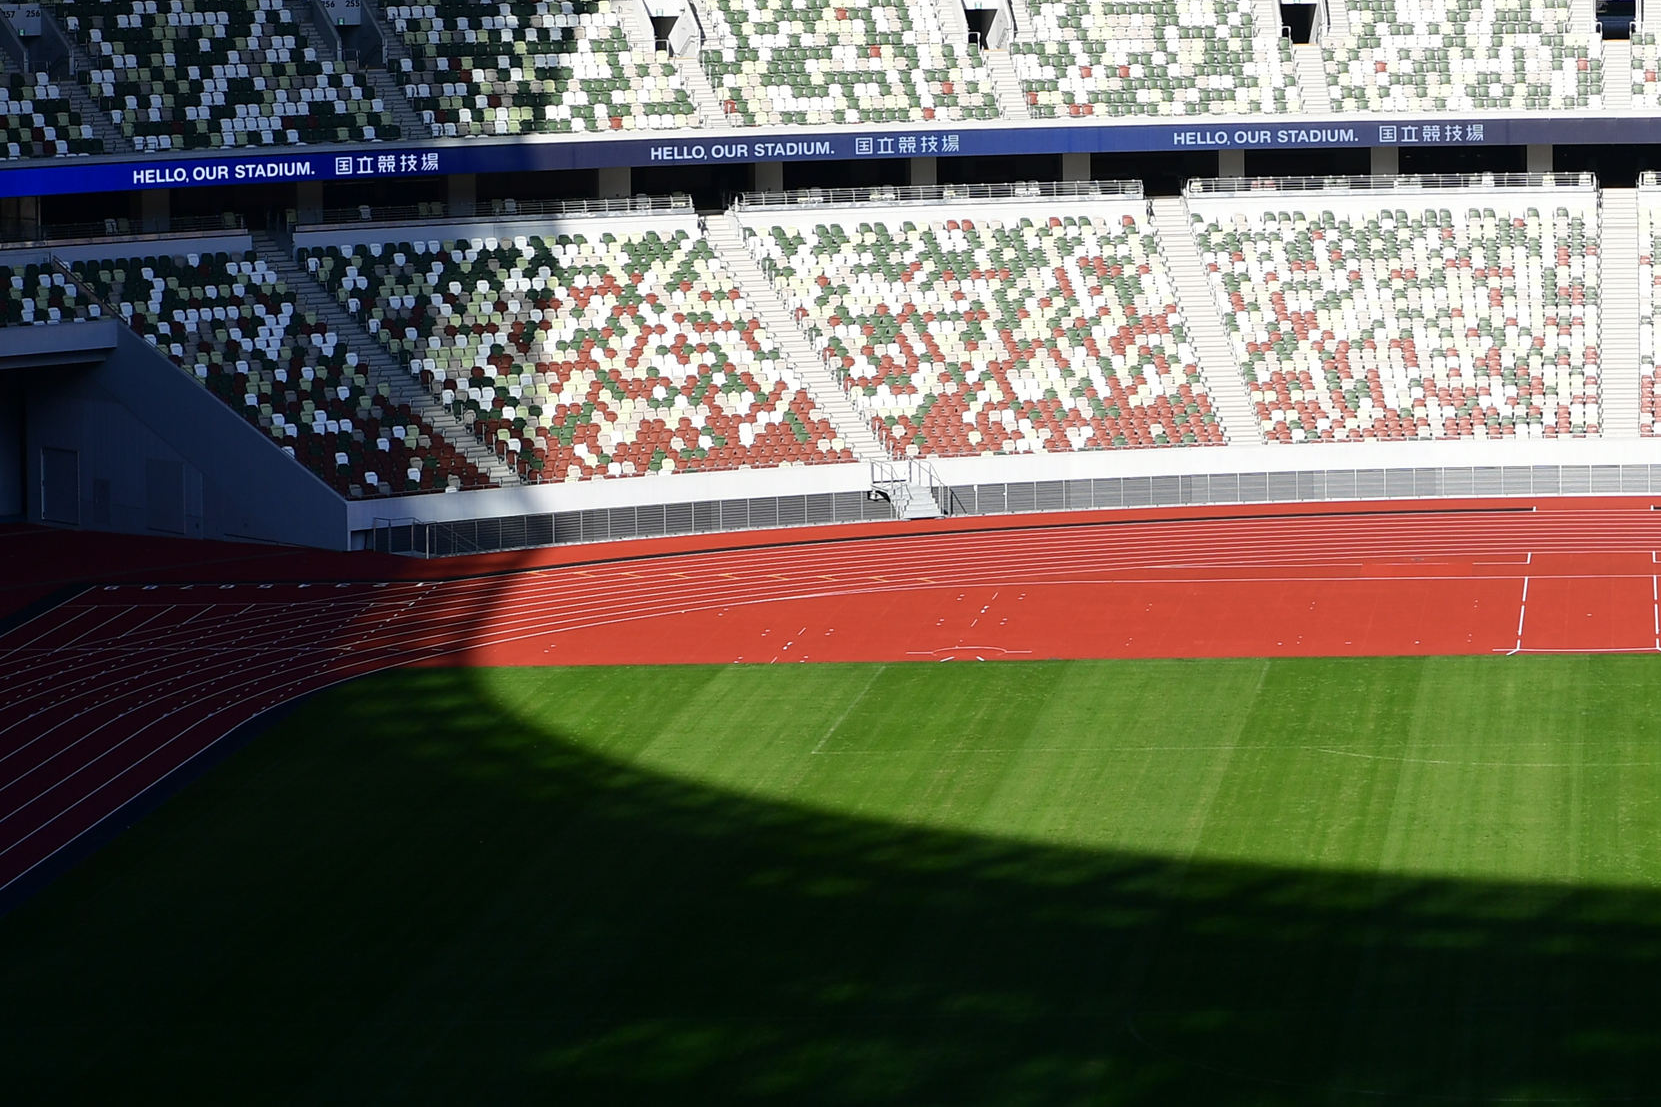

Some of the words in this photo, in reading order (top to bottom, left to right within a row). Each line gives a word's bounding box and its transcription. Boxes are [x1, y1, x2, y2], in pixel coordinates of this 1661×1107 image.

[345, 0, 360, 8] 255
[3, 10, 16, 19] 57
[25, 10, 41, 19] 256
[1174, 132, 1230, 145] HELLO,
[1235, 131, 1271, 143] OUR
[1278, 130, 1358, 142] STADIUM.
[1380, 125, 1483, 142] 国立競技場
[651, 146, 708, 160] HELLO,
[711, 144, 748, 158] OUR
[754, 142, 834, 156] STADIUM.
[856, 135, 959, 154] 国立競技場
[336, 154, 438, 175] 国立競技場
[133, 168, 190, 184] HELLO,
[193, 166, 228, 181] OUR
[235, 163, 315, 178] STADIUM.
